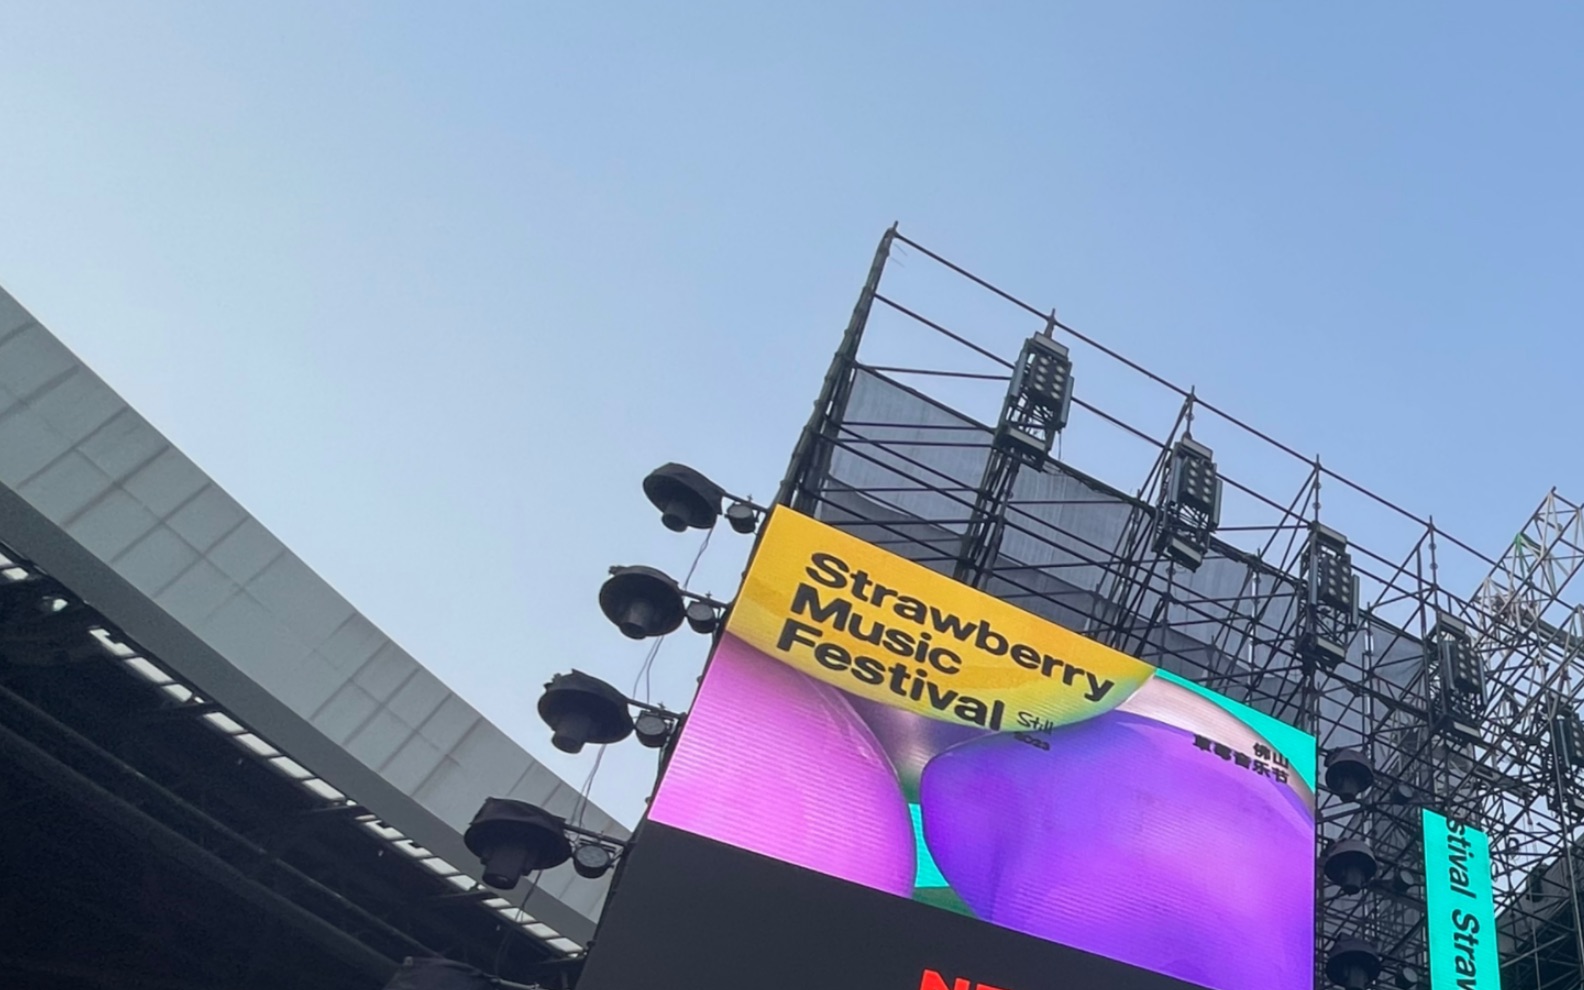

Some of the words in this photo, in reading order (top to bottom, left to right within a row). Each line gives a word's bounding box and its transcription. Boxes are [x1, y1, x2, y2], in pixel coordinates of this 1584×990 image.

[790, 585, 962, 675] Music
[806, 551, 1115, 703] Strawberry
[776, 618, 1006, 732] Festival
[1017, 711, 1053, 736] Still
[1192, 733, 1290, 784] 草莓音乐节
[1253, 742, 1289, 769] 佛山
